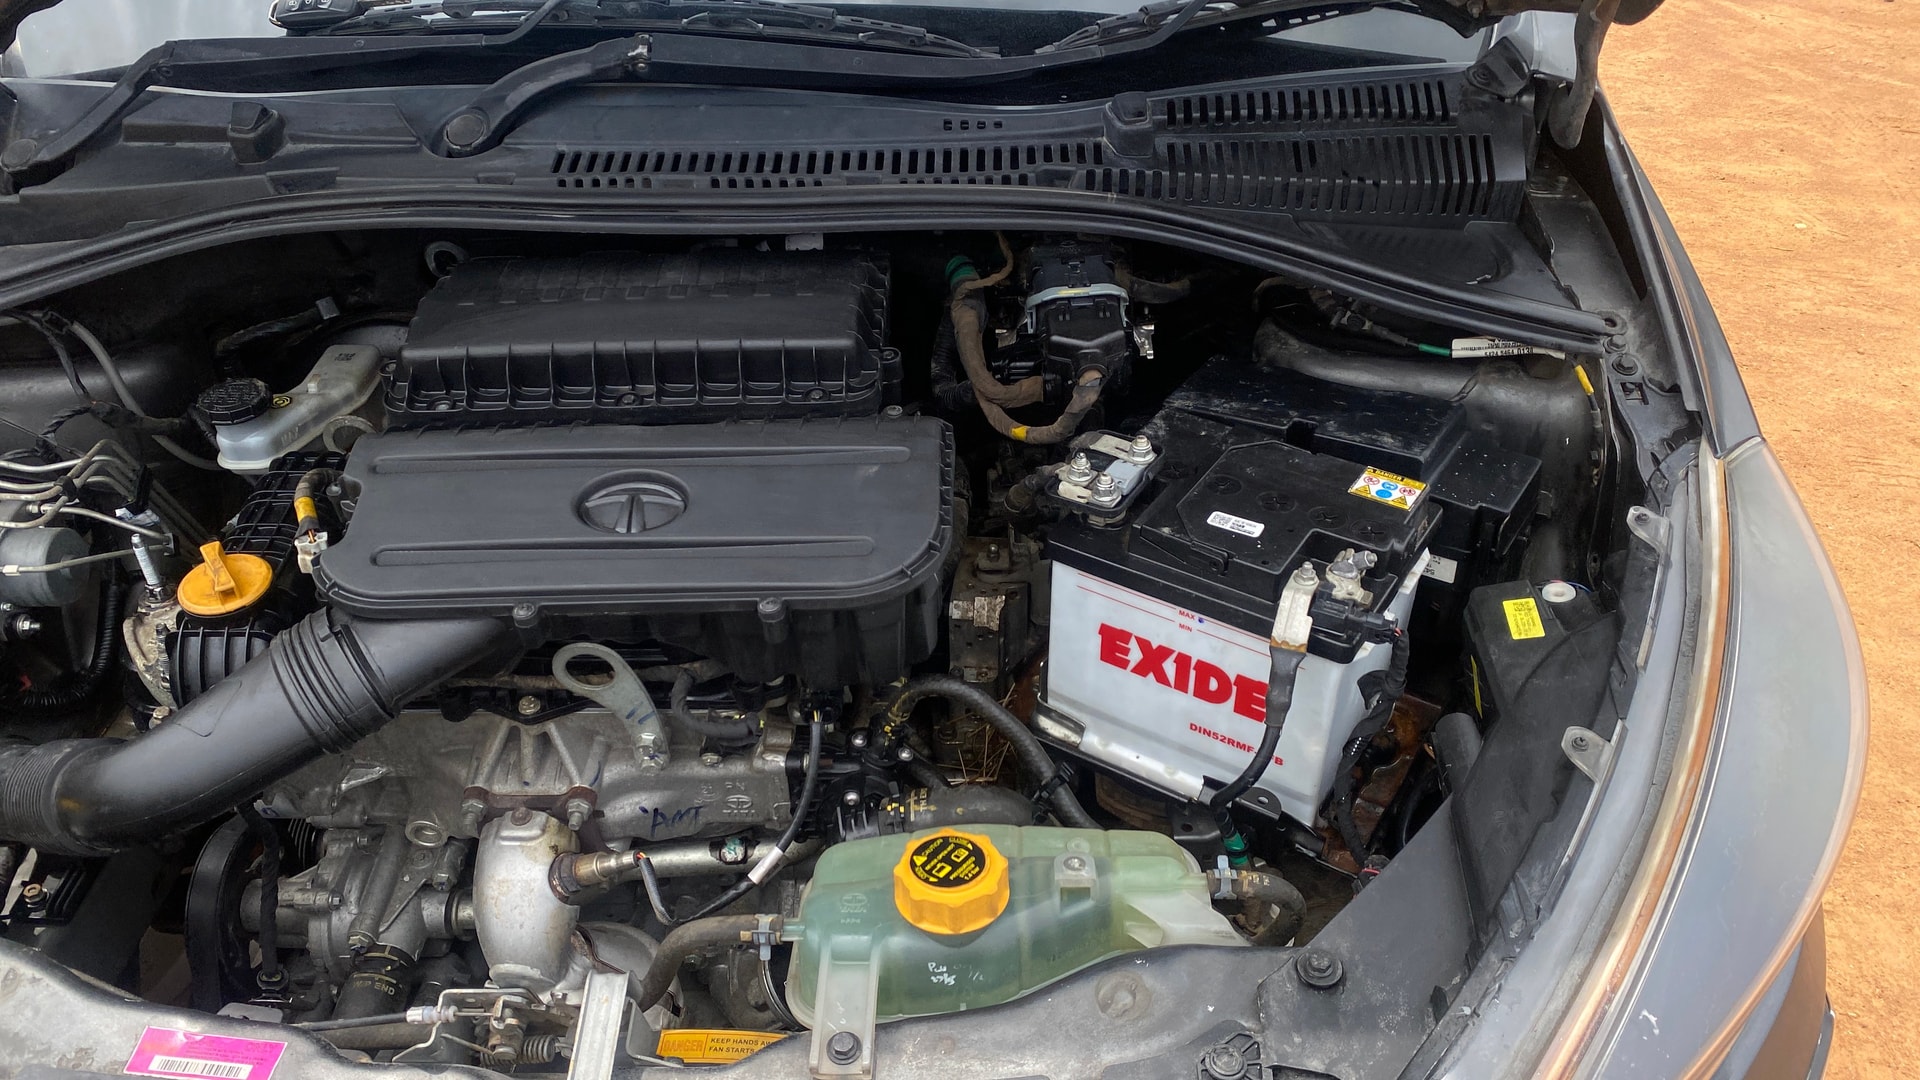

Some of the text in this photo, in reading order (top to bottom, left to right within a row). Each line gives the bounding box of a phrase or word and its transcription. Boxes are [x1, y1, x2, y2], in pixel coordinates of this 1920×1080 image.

[1178, 610, 1195, 620] MAX
[1178, 623, 1192, 632] MIN
[1098, 622, 1269, 723] EXIDE
[663, 1039, 703, 1052] DANGER
